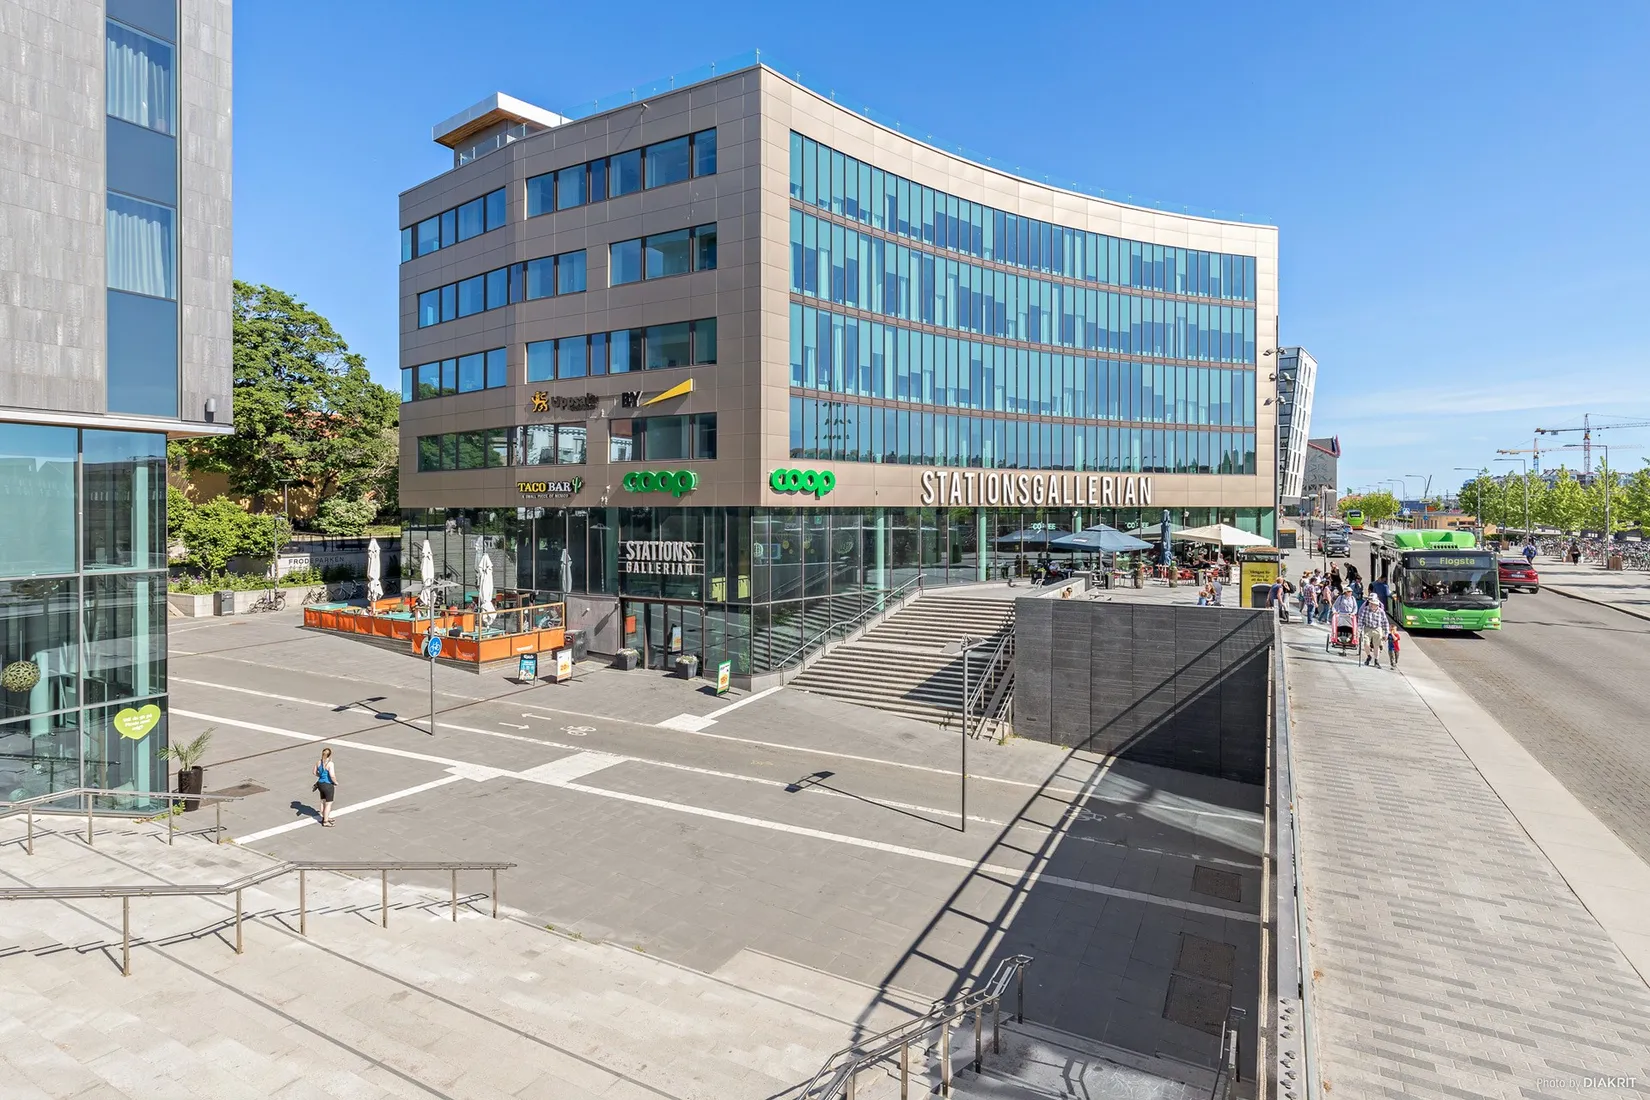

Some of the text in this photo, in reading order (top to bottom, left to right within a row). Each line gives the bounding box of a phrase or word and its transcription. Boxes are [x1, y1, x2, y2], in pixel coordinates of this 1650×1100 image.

[517, 481, 572, 493] TACO BAR
[623, 470, 696, 498] coop
[772, 468, 837, 497] coop
[921, 470, 1152, 506] STATIONSGALLERIAN
[626, 540, 693, 562] STATIONS
[288, 556, 345, 565] FRODEPARKEN
[626, 561, 693, 576] GALLERIAN
[1419, 557, 1475, 567] 6 Flogsta
